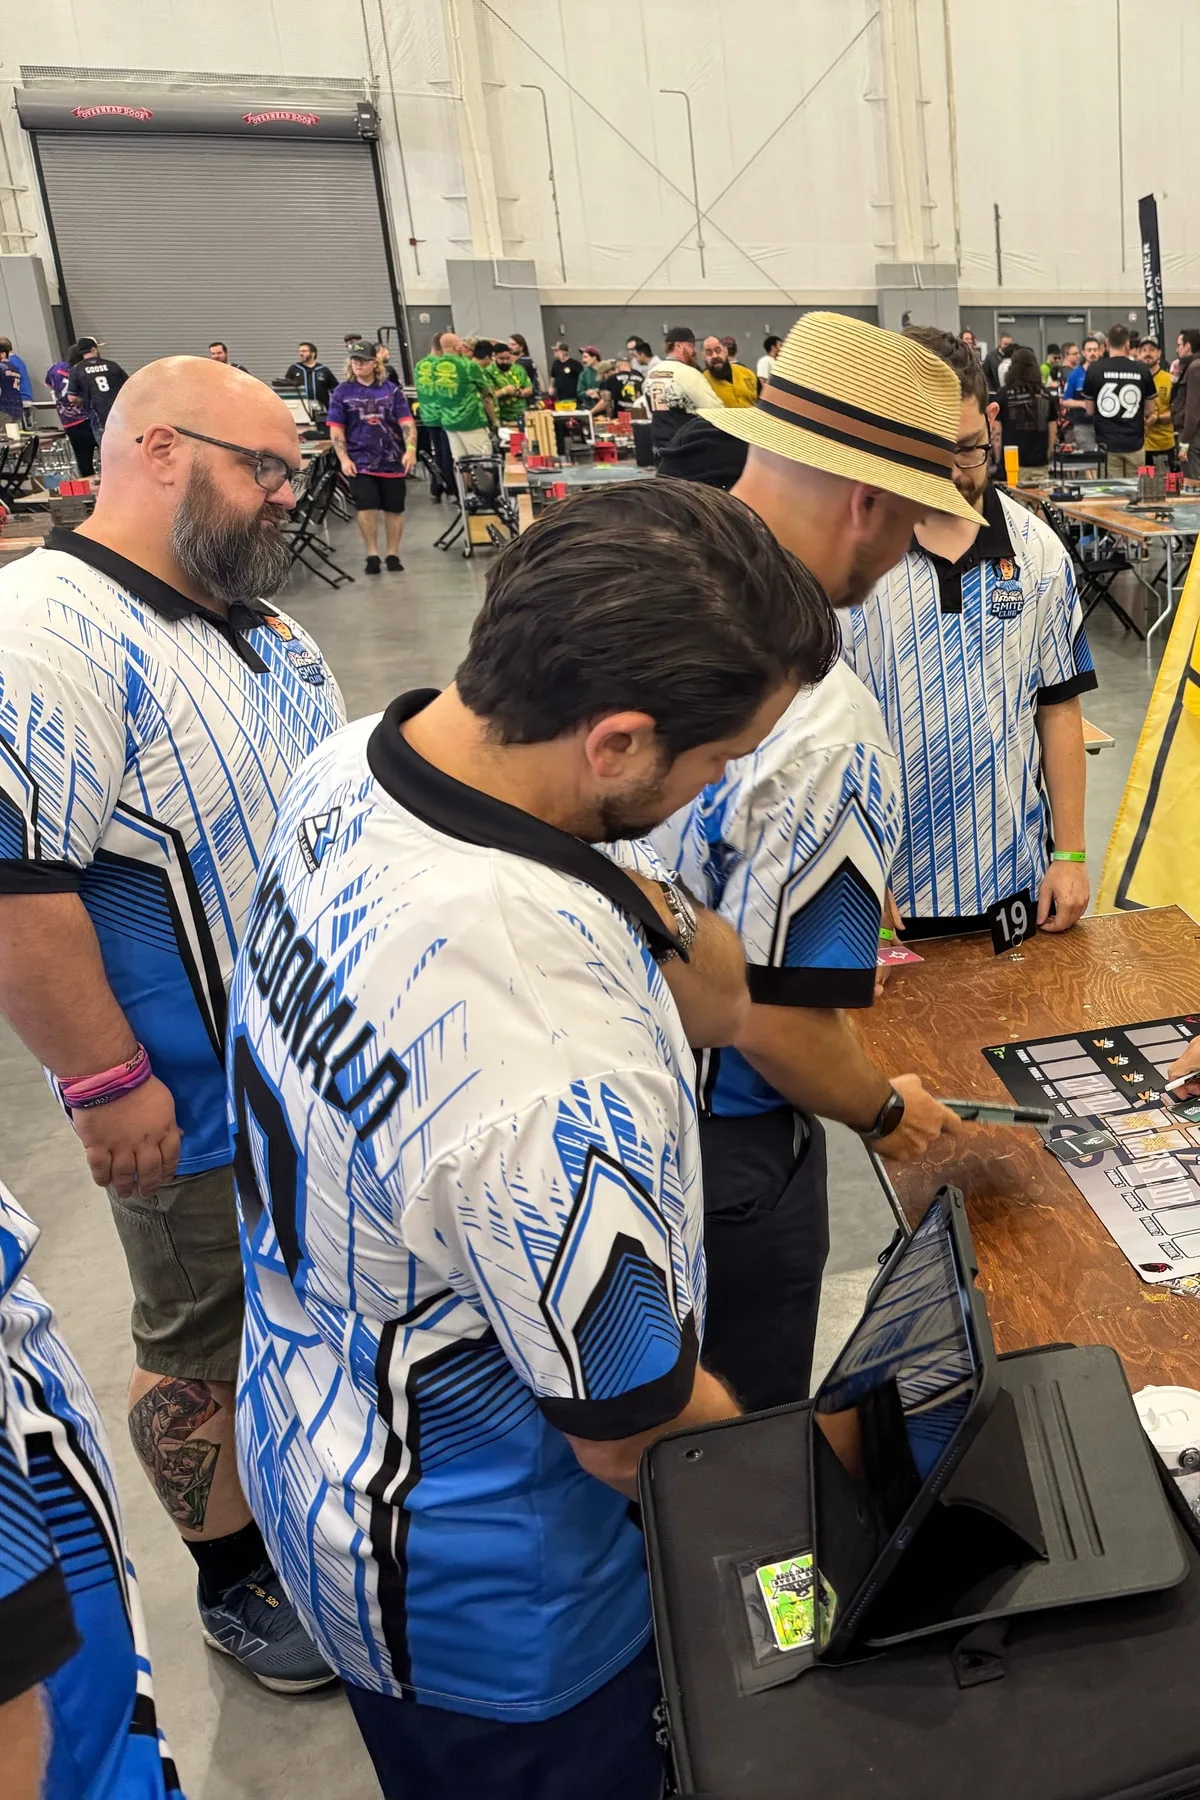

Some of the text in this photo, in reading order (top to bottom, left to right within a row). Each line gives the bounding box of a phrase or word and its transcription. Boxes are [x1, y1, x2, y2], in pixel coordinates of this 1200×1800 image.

[82, 106, 145, 120] OVERHEAD DOOR
[253, 112, 312, 126] OVERHEAD DOOR
[1143, 243, 1155, 311] BANNER
[85, 364, 108, 374] GOOSE
[95, 376, 110, 392] 8
[1097, 382, 1142, 418] 69
[992, 600, 1024, 613] SMITE
[998, 610, 1017, 618] CLUB
[301, 839, 317, 872] LEAGUE
[995, 900, 1028, 942] 19
